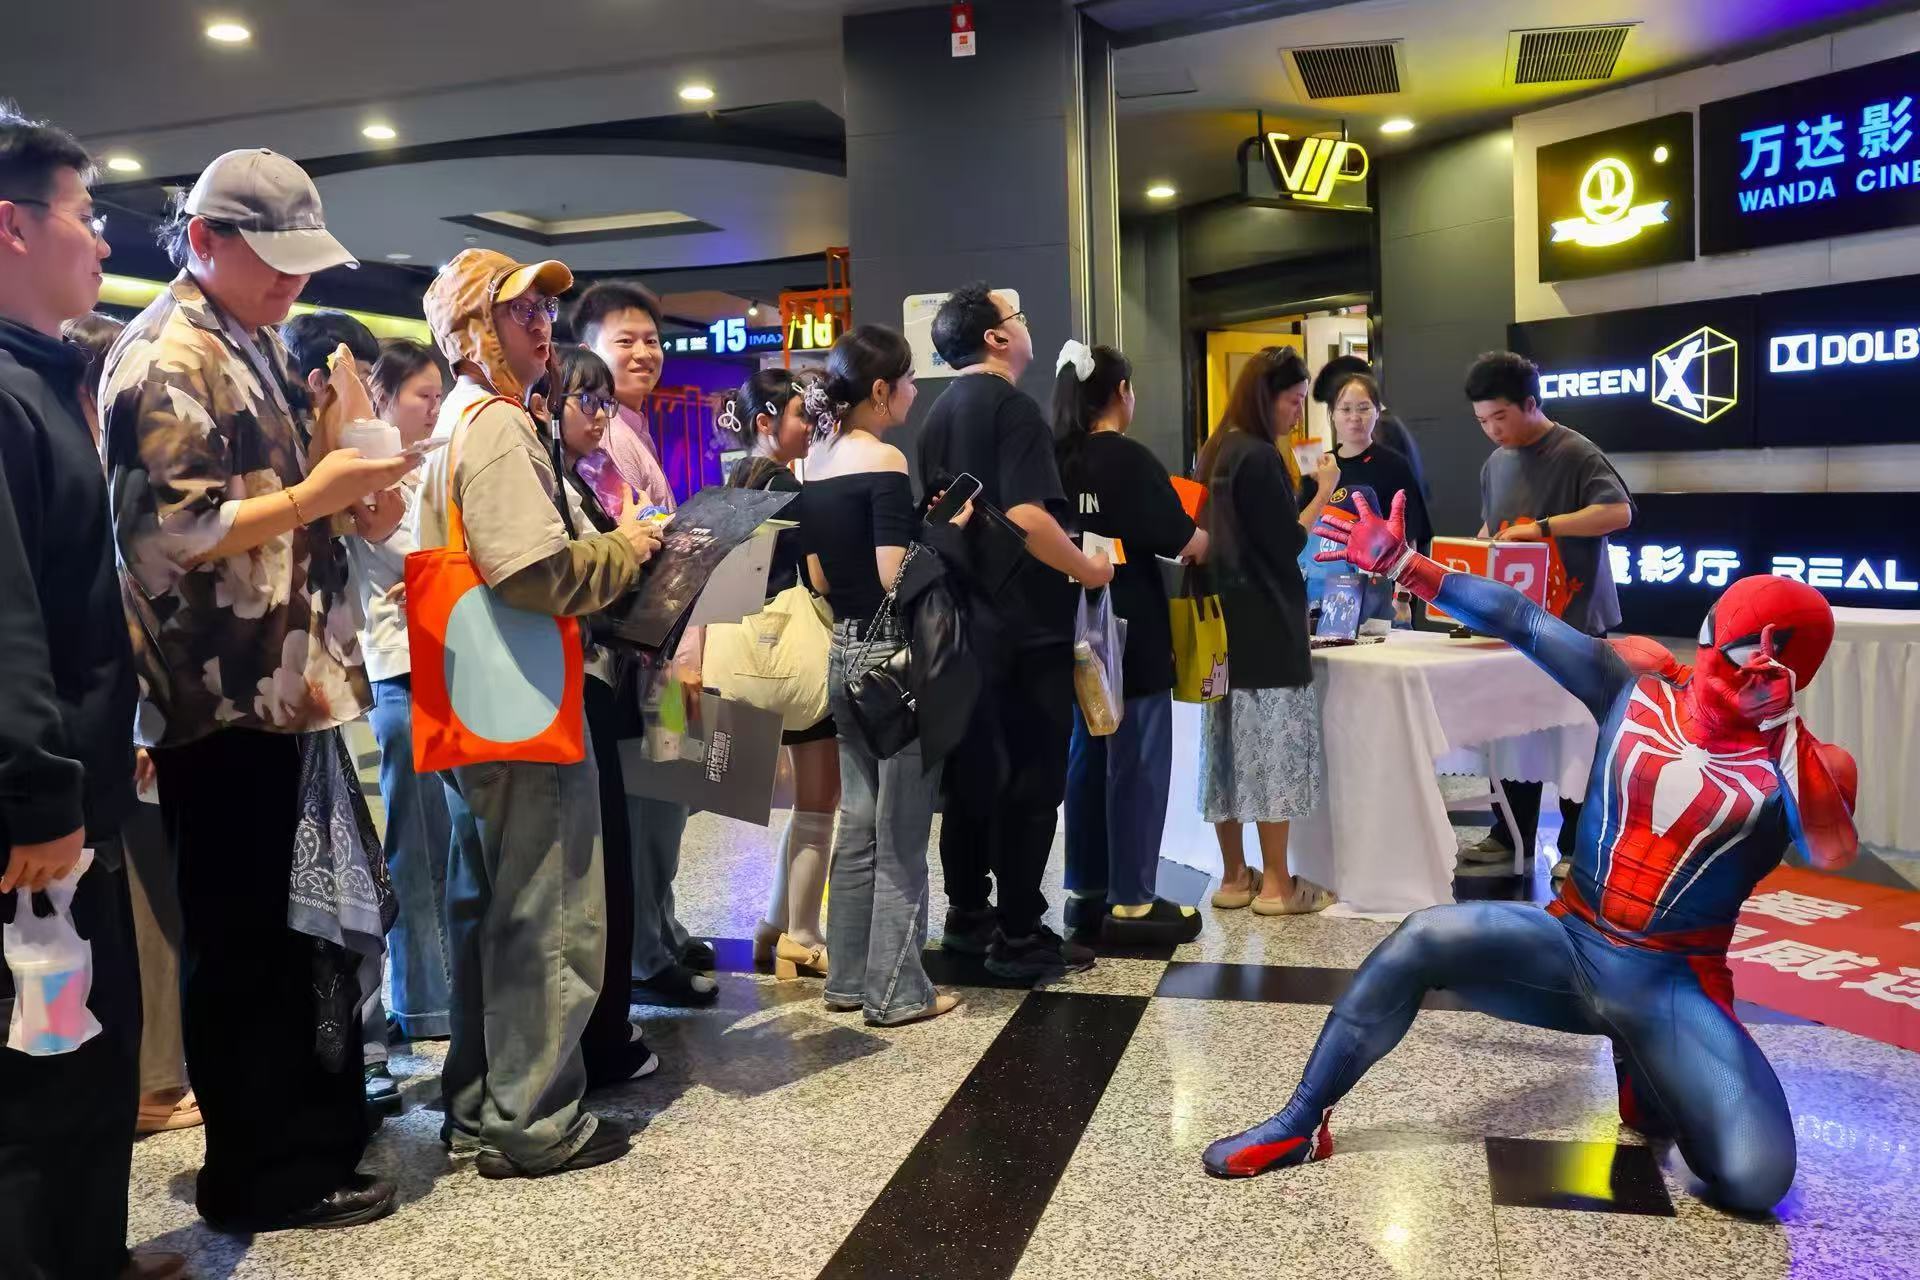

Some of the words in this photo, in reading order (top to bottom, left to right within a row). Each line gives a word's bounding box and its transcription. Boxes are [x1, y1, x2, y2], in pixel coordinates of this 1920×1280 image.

[1738, 96, 1913, 181] 万达影
[1267, 132, 1369, 202] VIP
[1738, 176, 1836, 212] WANDA
[709, 317, 747, 353] 15
[1821, 328, 1920, 366] DOLB
[1539, 367, 1646, 399] CREEN
[1772, 556, 1919, 591] REAL
